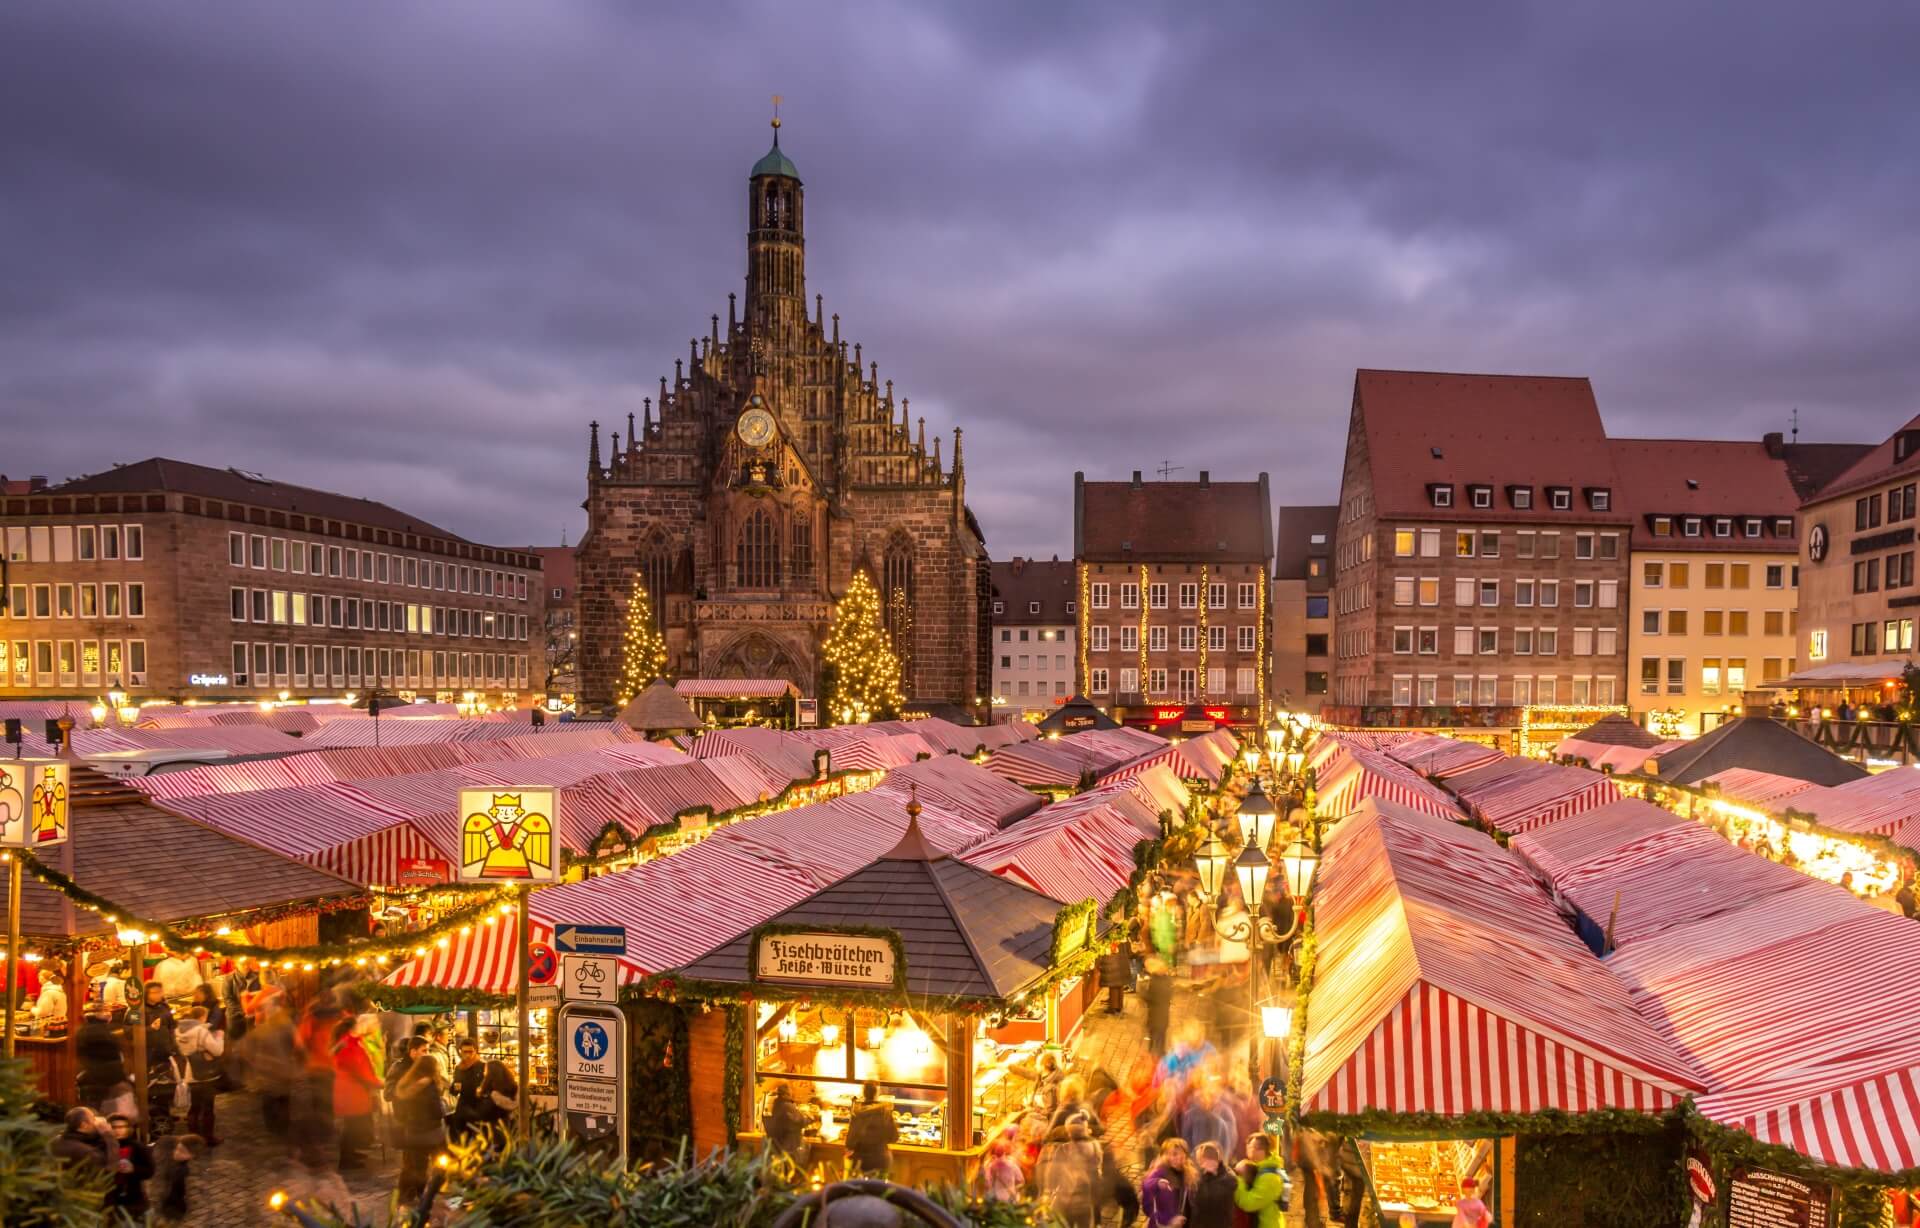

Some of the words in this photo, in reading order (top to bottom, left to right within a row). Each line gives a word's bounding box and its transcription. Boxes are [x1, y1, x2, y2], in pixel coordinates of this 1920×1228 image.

[575, 935, 622, 944] Einbahnstraße
[770, 940, 884, 963] Fischbrötchen
[578, 1062, 605, 1074] ZONE
